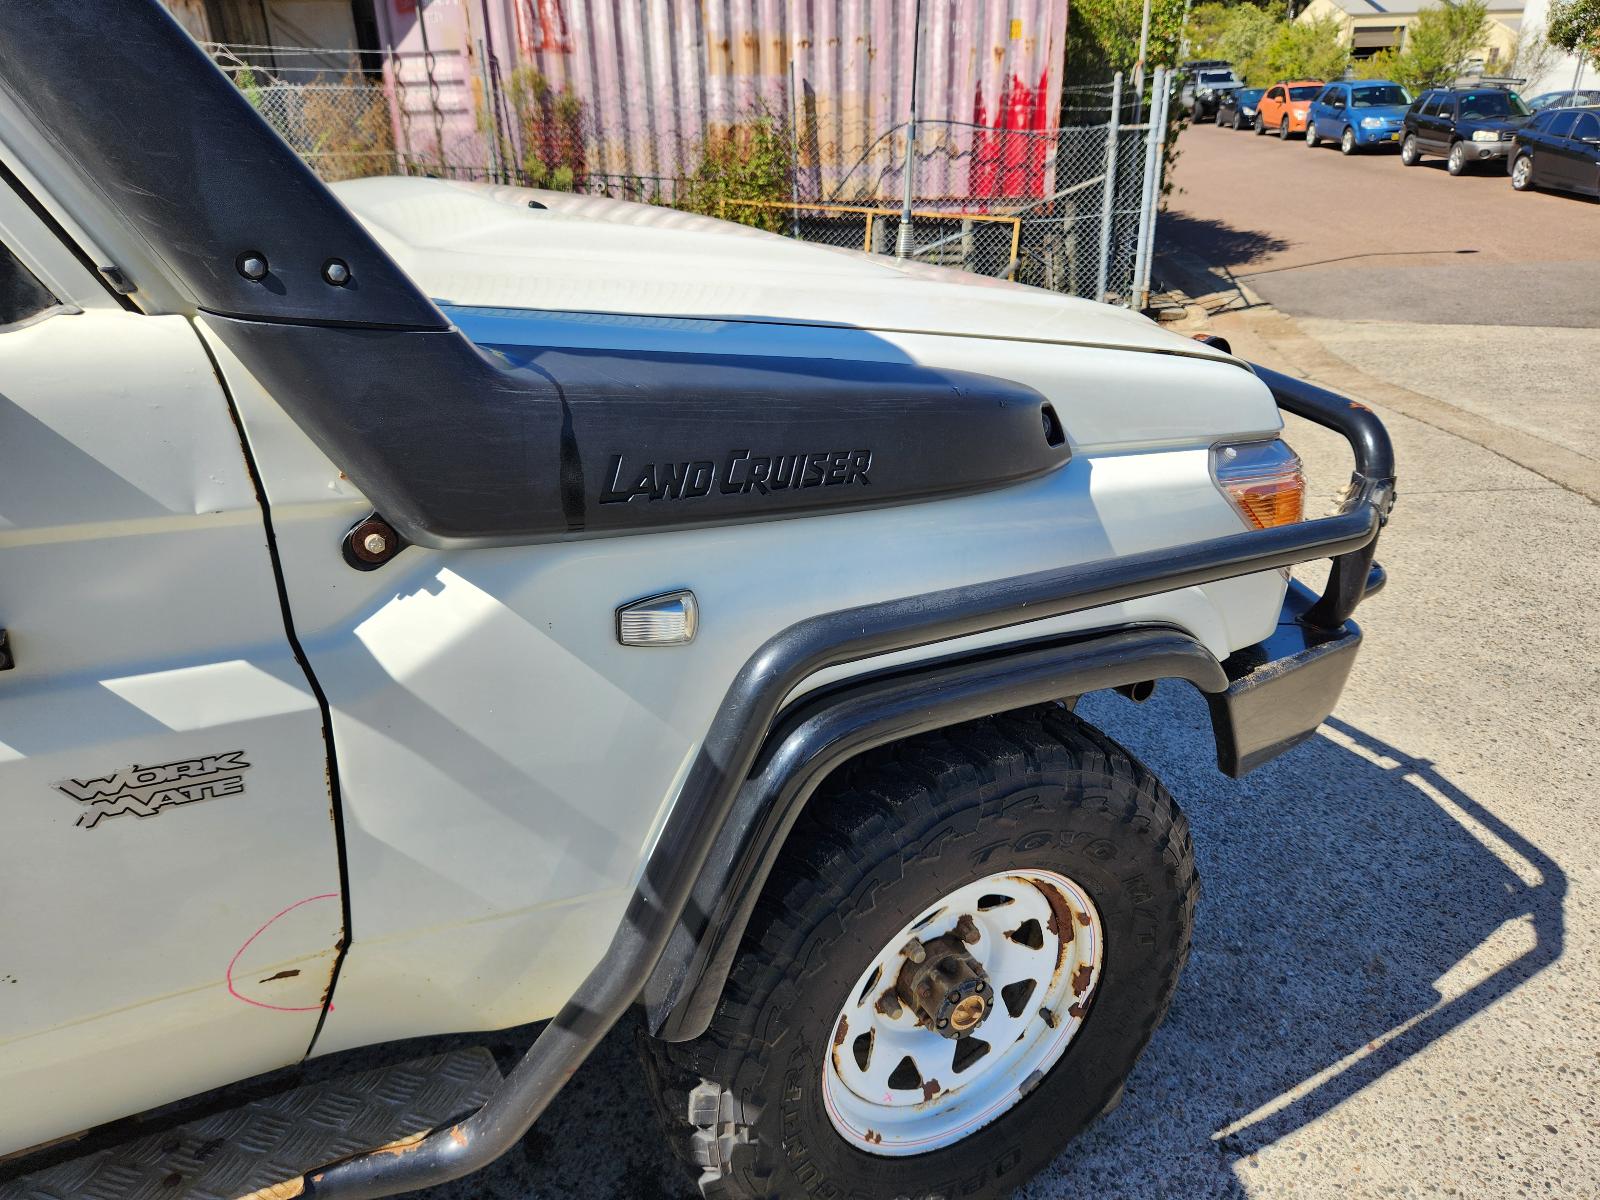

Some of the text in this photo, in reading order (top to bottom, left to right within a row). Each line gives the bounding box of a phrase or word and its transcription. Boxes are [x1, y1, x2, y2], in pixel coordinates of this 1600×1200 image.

[599, 449, 873, 504] LAND CRUISER
[55, 750, 251, 802] WORK
[73, 775, 245, 829] MATE
[969, 828, 1119, 868] TOYO
